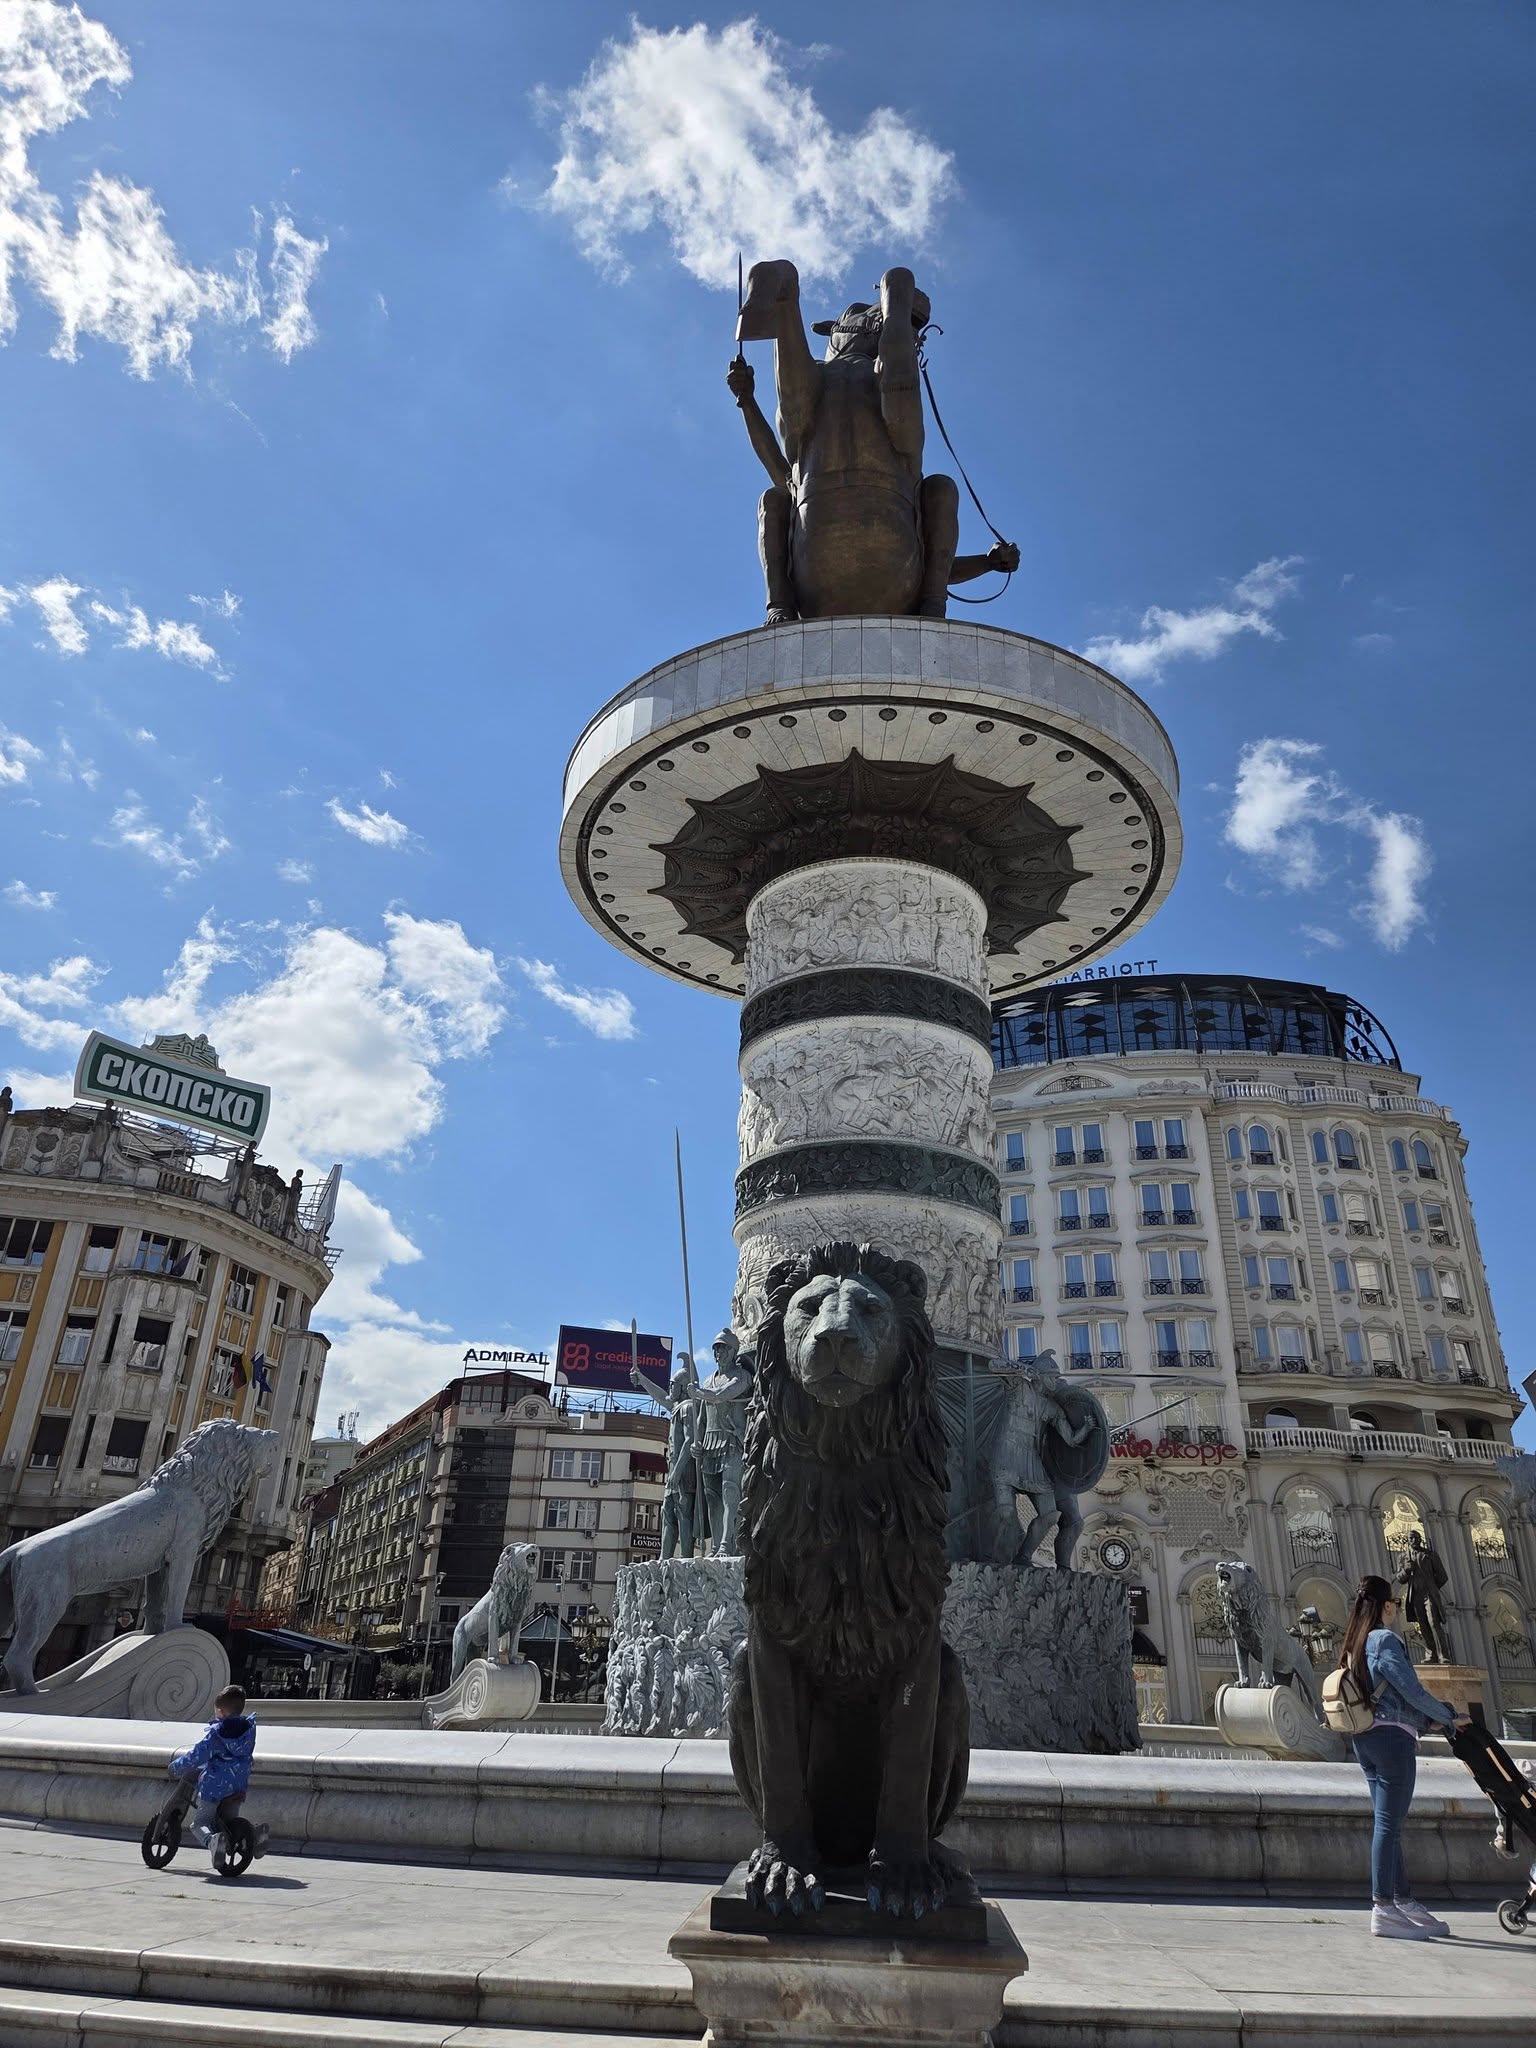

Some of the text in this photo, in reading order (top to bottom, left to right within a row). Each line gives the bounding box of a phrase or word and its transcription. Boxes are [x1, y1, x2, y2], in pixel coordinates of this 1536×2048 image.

[96, 1053, 256, 1128] СКОПСКО
[463, 1348, 550, 1366] ADMIRAL
[594, 1351, 667, 1368] credissimo
[1156, 1438, 1239, 1467] Skopje
